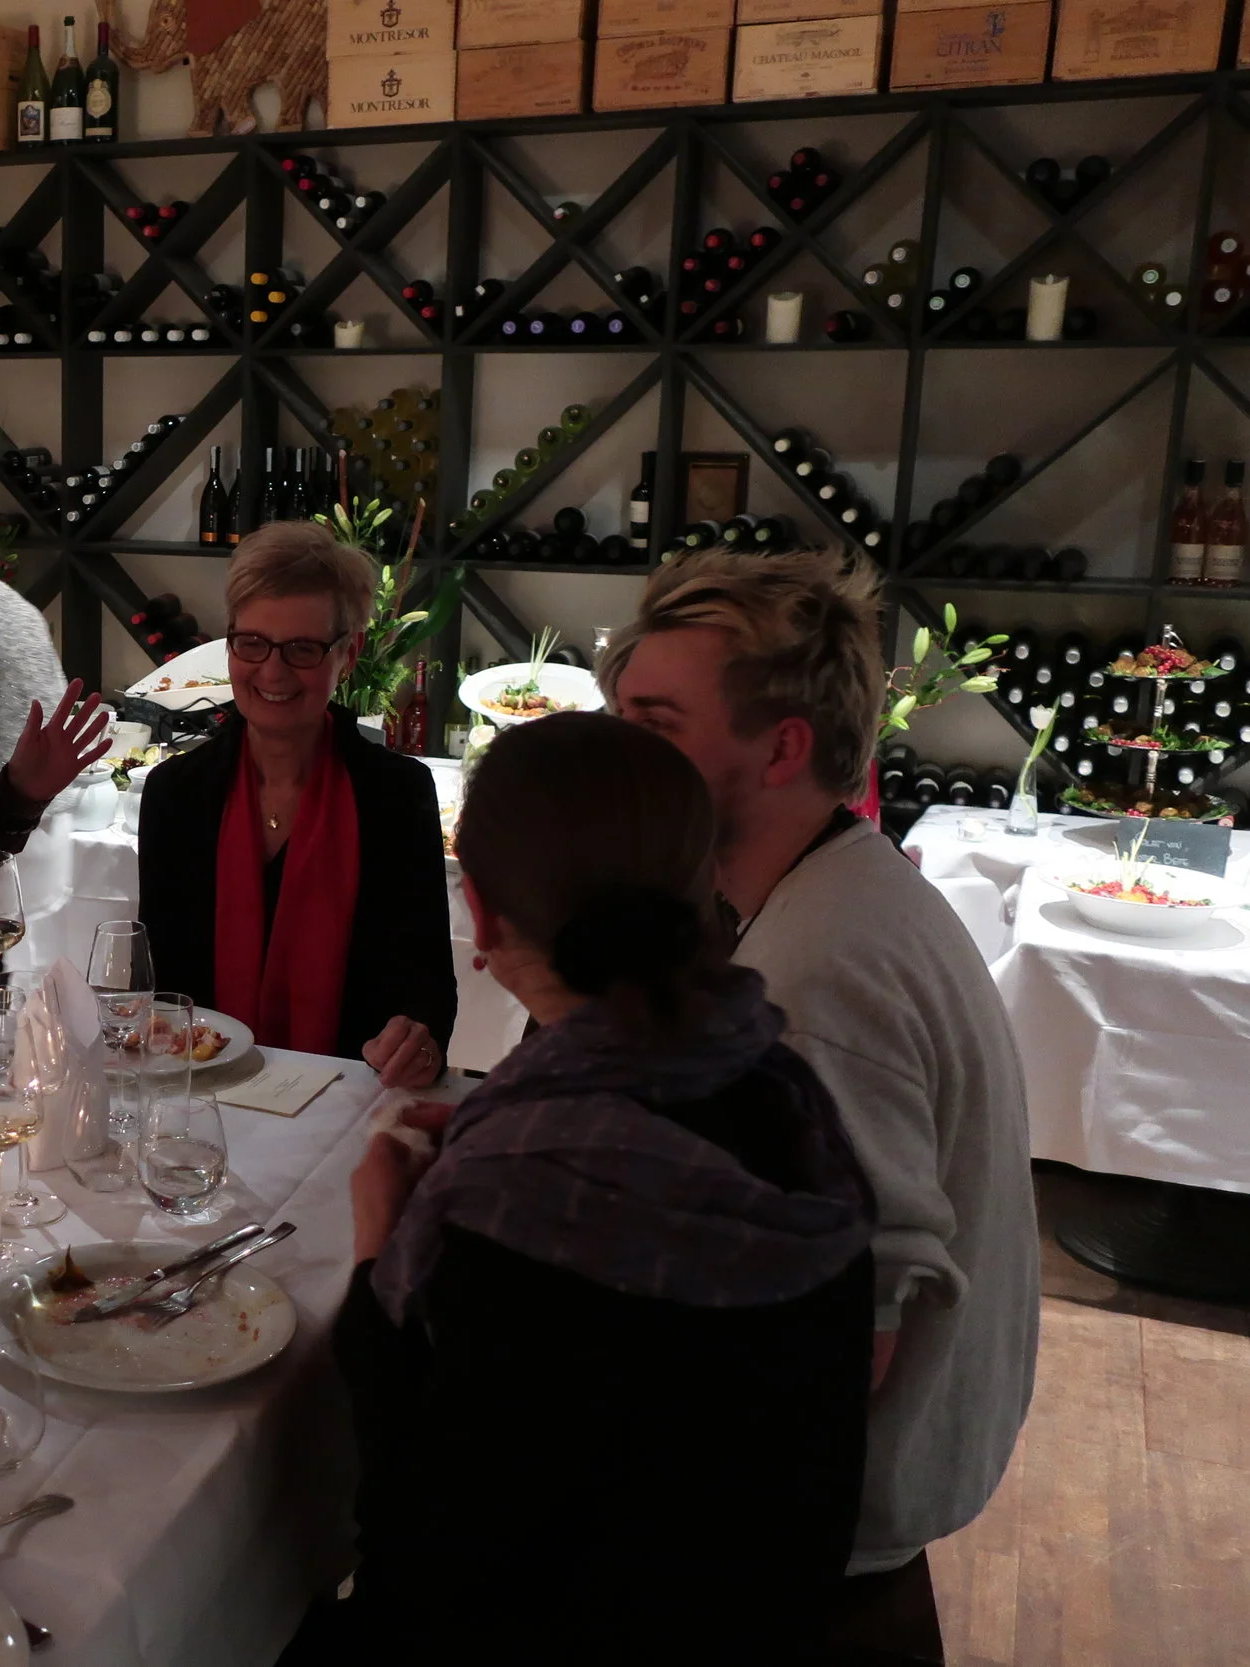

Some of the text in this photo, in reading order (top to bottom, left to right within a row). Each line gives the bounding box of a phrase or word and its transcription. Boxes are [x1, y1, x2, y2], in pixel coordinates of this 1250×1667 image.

[349, 27, 430, 46] MONTRESOR
[811, 47, 863, 60] MAGNOL
[934, 39, 1003, 58] CITRAN
[350, 97, 431, 114] MONTRESOR
